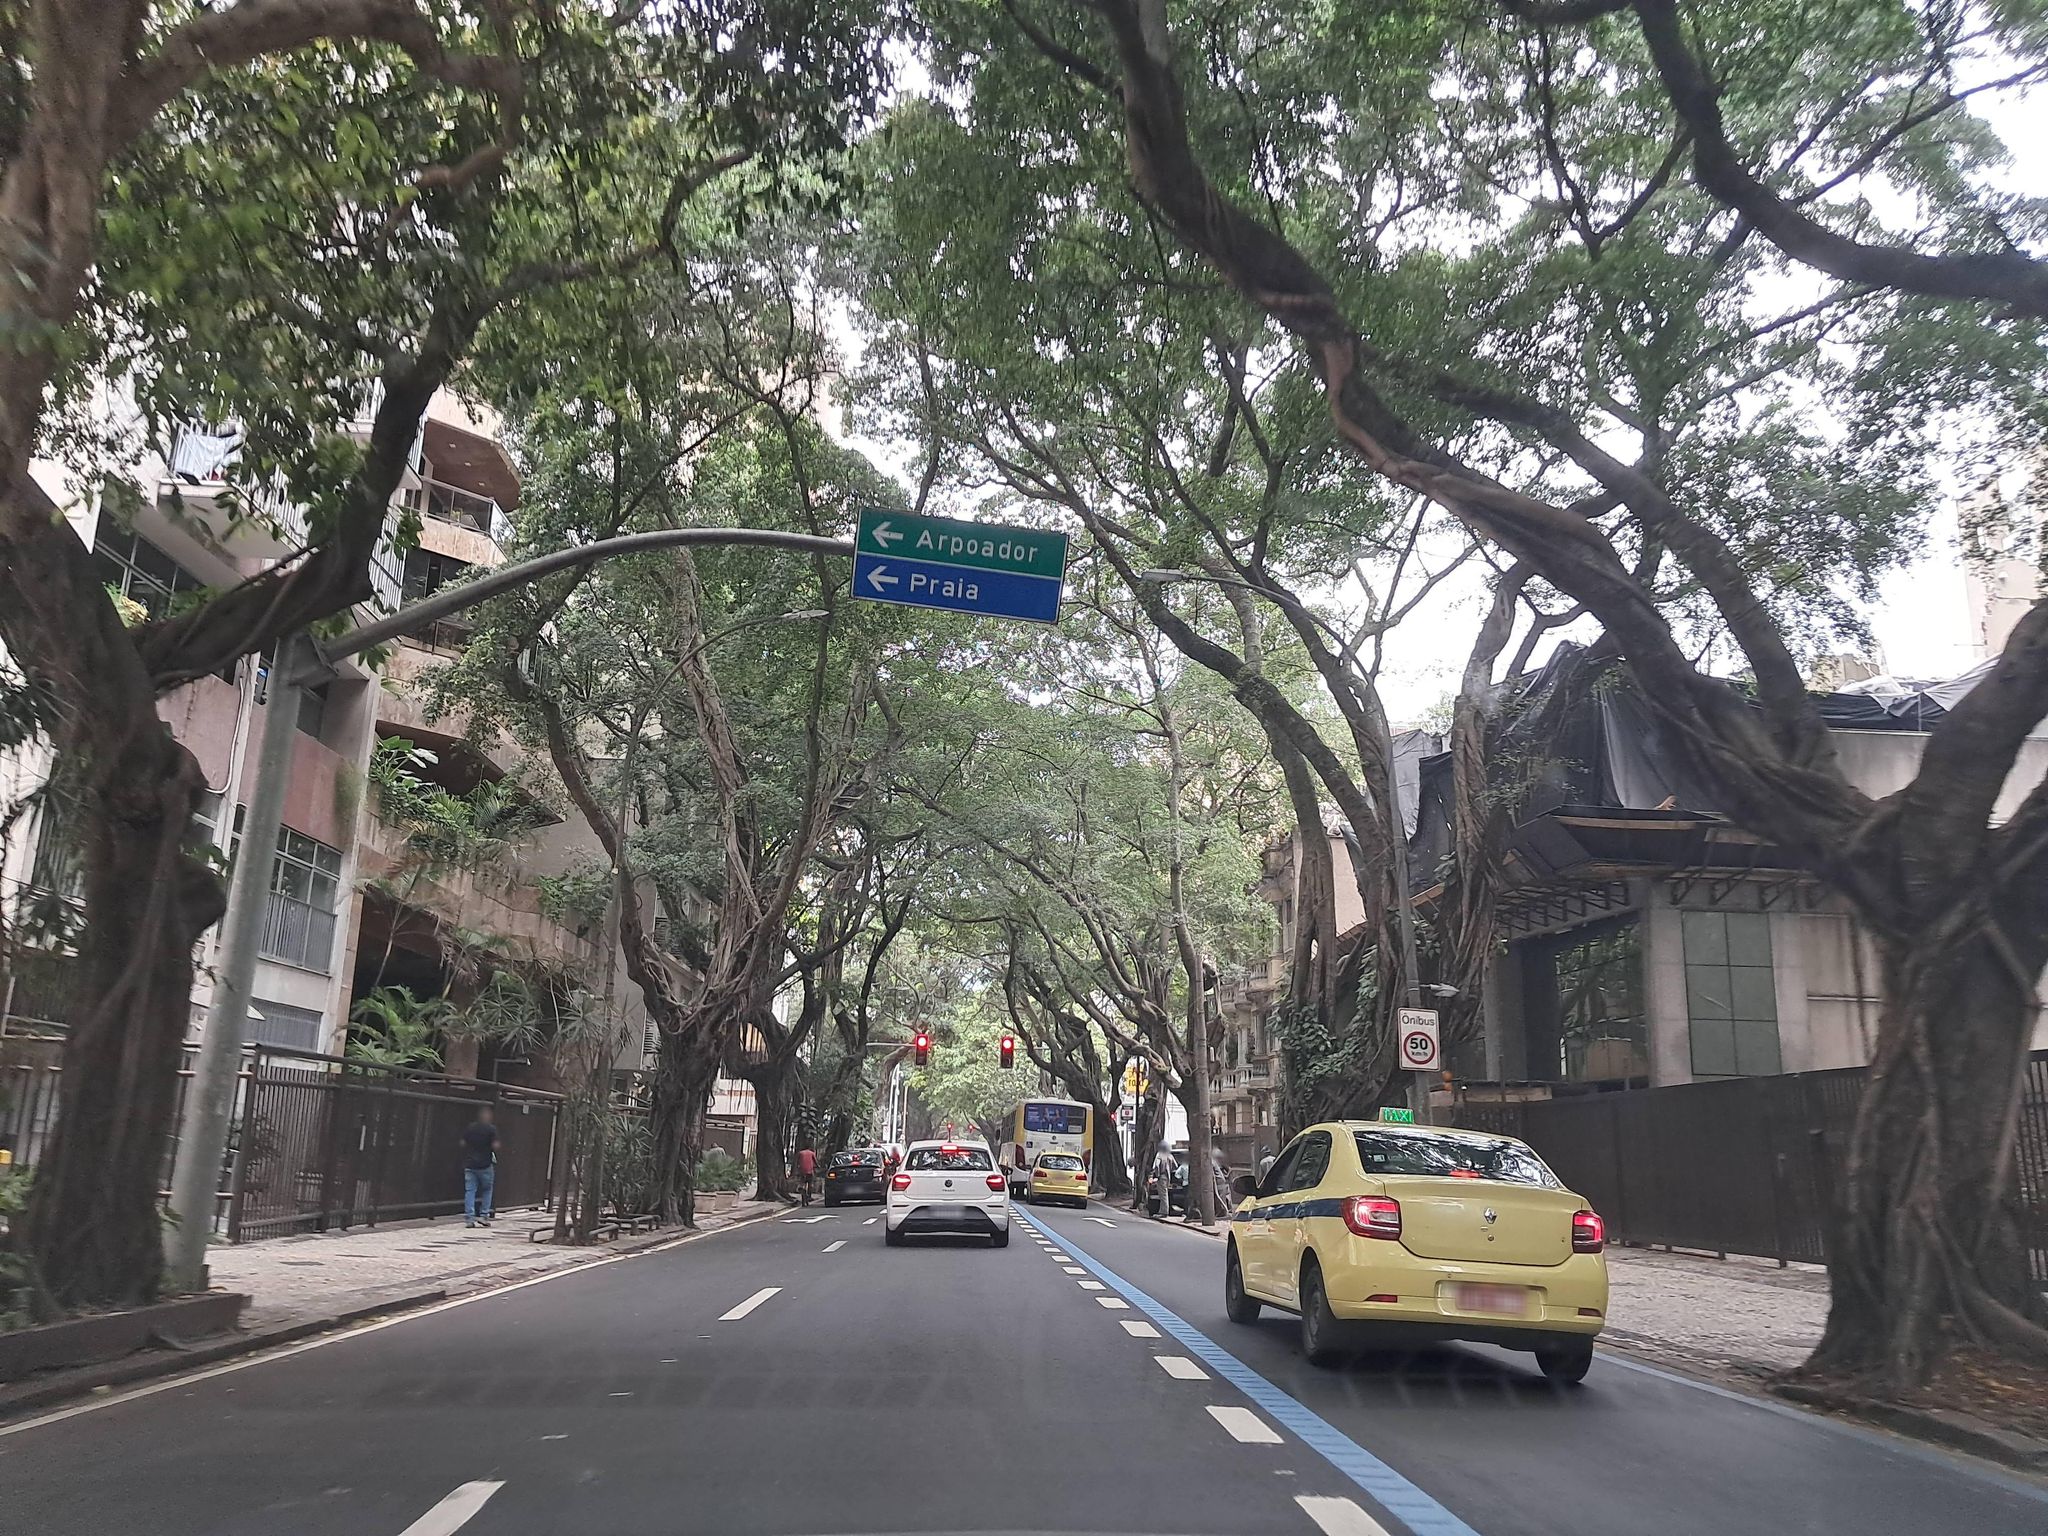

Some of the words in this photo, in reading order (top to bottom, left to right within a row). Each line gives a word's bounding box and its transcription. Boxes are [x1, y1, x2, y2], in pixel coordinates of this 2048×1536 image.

[915, 529, 1039, 563] Arpoador
[909, 573, 979, 600] Praia
[1410, 1037, 1428, 1050] 50
[1384, 1108, 1412, 1123] TAXI
